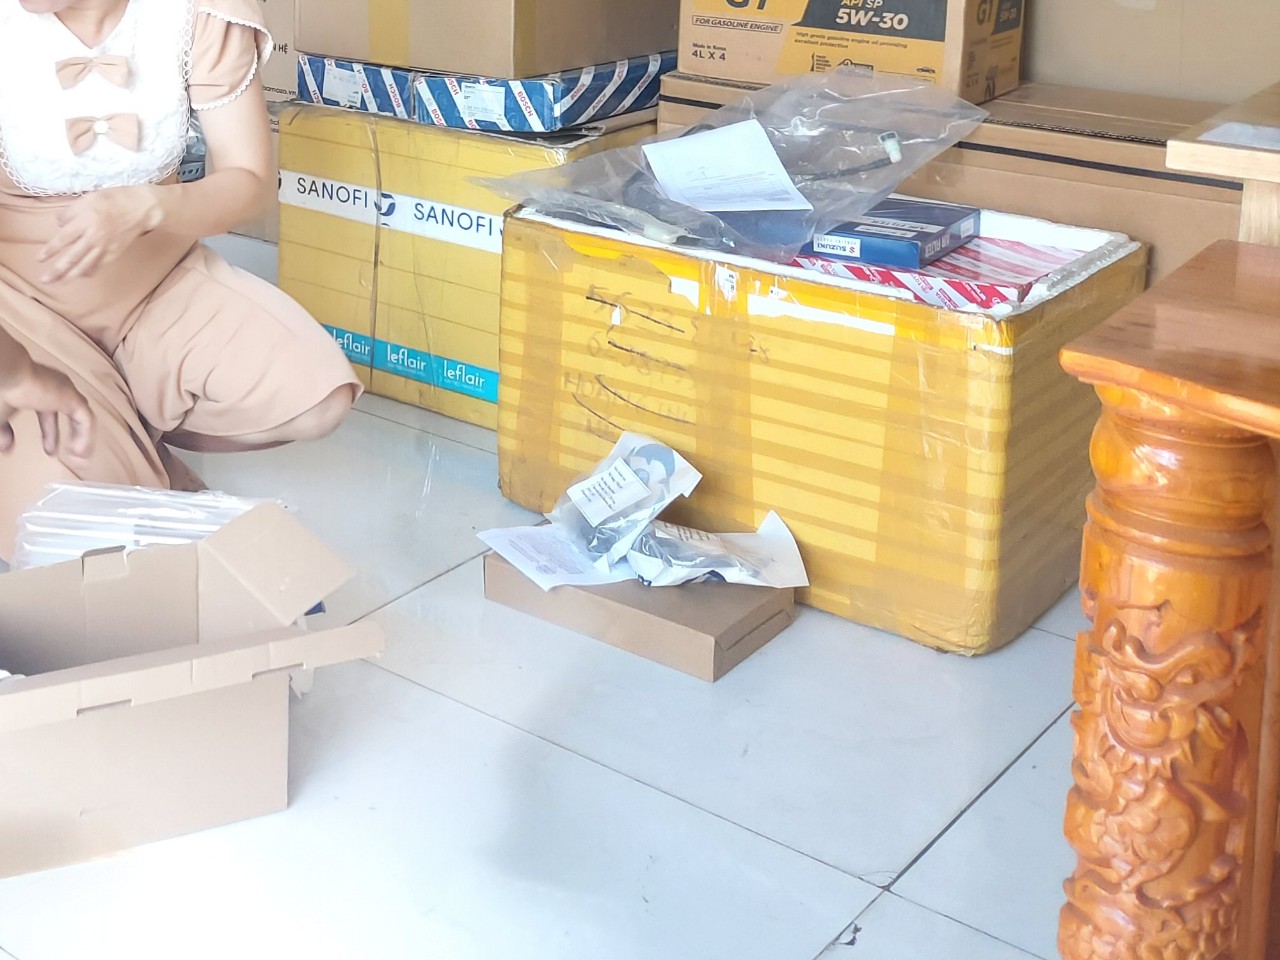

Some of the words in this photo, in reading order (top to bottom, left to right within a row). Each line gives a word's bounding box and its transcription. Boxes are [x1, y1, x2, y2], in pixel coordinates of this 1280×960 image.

[695, 18, 710, 26] FOR
[710, 19, 749, 31] GASOLINE
[750, 23, 779, 32] ENGINE
[836, 8, 909, 30] 5W-30
[278, 42, 289, 55] HỆ
[794, 38, 818, 46] excellent
[819, 40, 849, 50] protection
[796, 31, 809, 39] High
[810, 33, 826, 41] grade
[827, 34, 850, 42] gasoline
[851, 37, 870, 46] engine
[879, 41, 908, 49] providing
[692, 50, 705, 59] 4L
[719, 52, 726, 61] 4
[518, 91, 534, 117] BOSCH
[297, 177, 368, 208] SANOFI
[414, 203, 493, 236] SANOFI
[817, 243, 847, 252] SUZUKI
[387, 344, 427, 371] leflair
[444, 360, 486, 389] leflair
